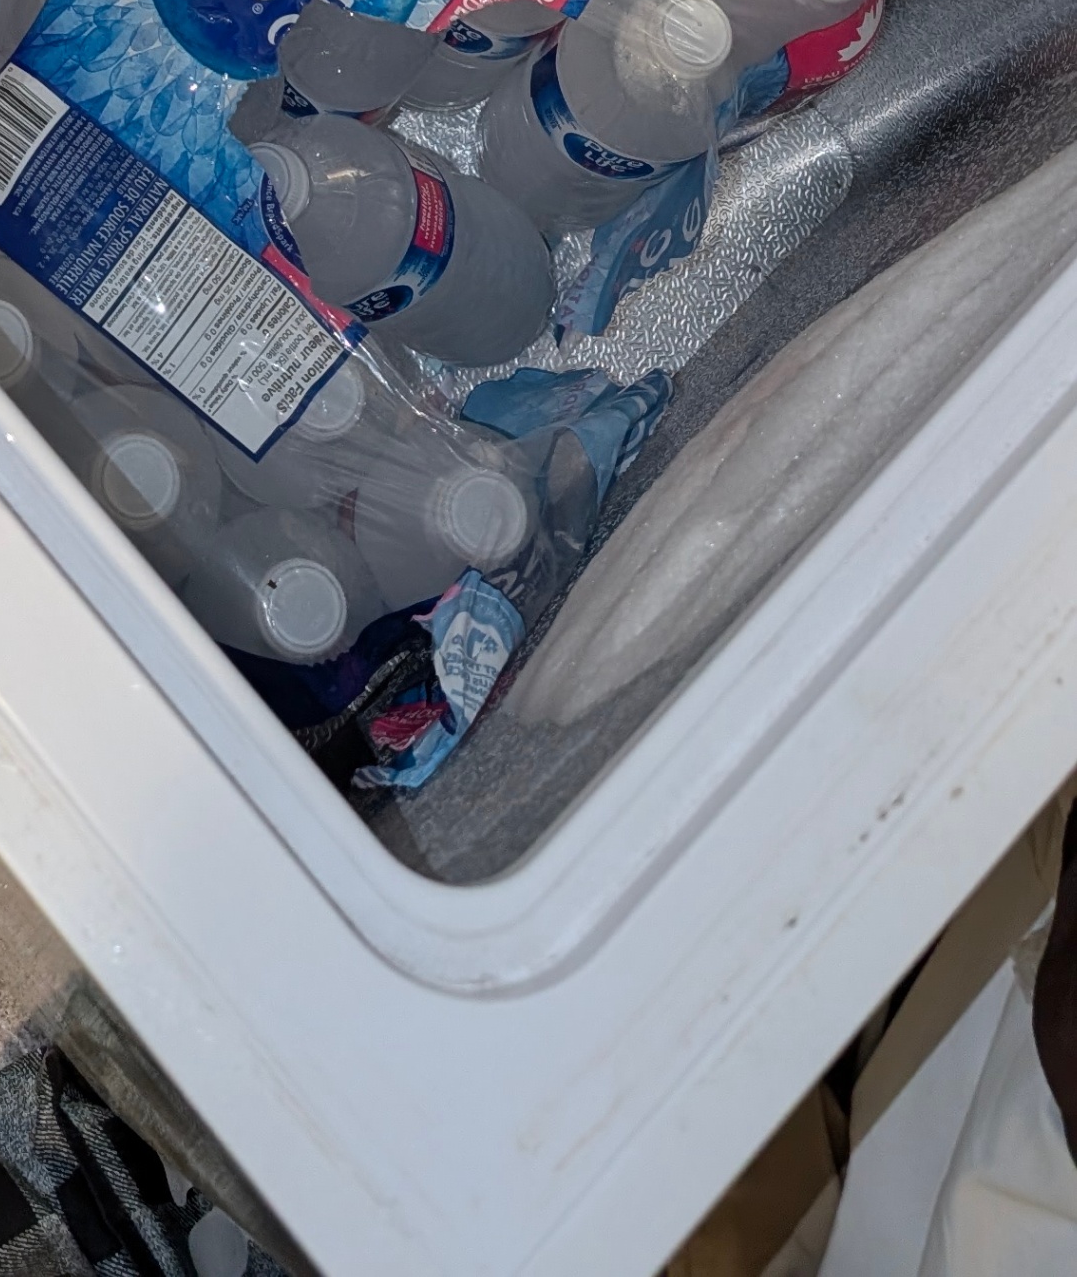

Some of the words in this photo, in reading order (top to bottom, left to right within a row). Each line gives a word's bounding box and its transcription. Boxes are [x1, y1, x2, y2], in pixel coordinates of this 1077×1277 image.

[583, 139, 645, 169] Pure
[122, 185, 141, 206] DE
[131, 165, 156, 193] EAU
[94, 199, 130, 243] SOURCE
[126, 176, 168, 228] NATURAL
[54, 236, 103, 296] NATURELLE
[95, 224, 133, 269] SPRING
[67, 264, 102, 306] WATER
[266, 295, 296, 331] Calories
[297, 329, 328, 361] Valeur
[299, 340, 341, 385] Nutrition
[259, 357, 303, 404] nutritive
[274, 381, 306, 414] Facts
